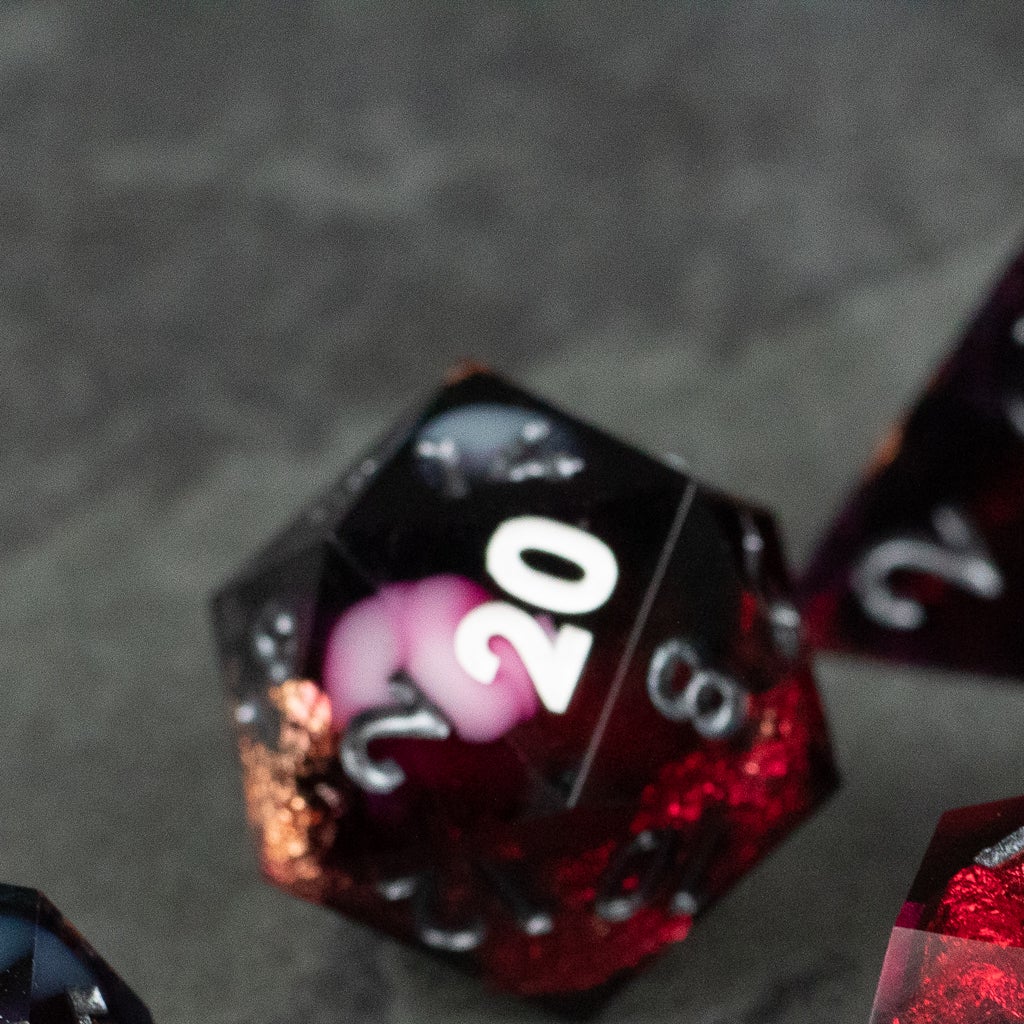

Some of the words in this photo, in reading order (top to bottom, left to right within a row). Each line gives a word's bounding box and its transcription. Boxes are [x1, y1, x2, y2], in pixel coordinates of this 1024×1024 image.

[454, 515, 619, 716] 20
[853, 507, 1003, 632] 2
[647, 639, 747, 741] 8
